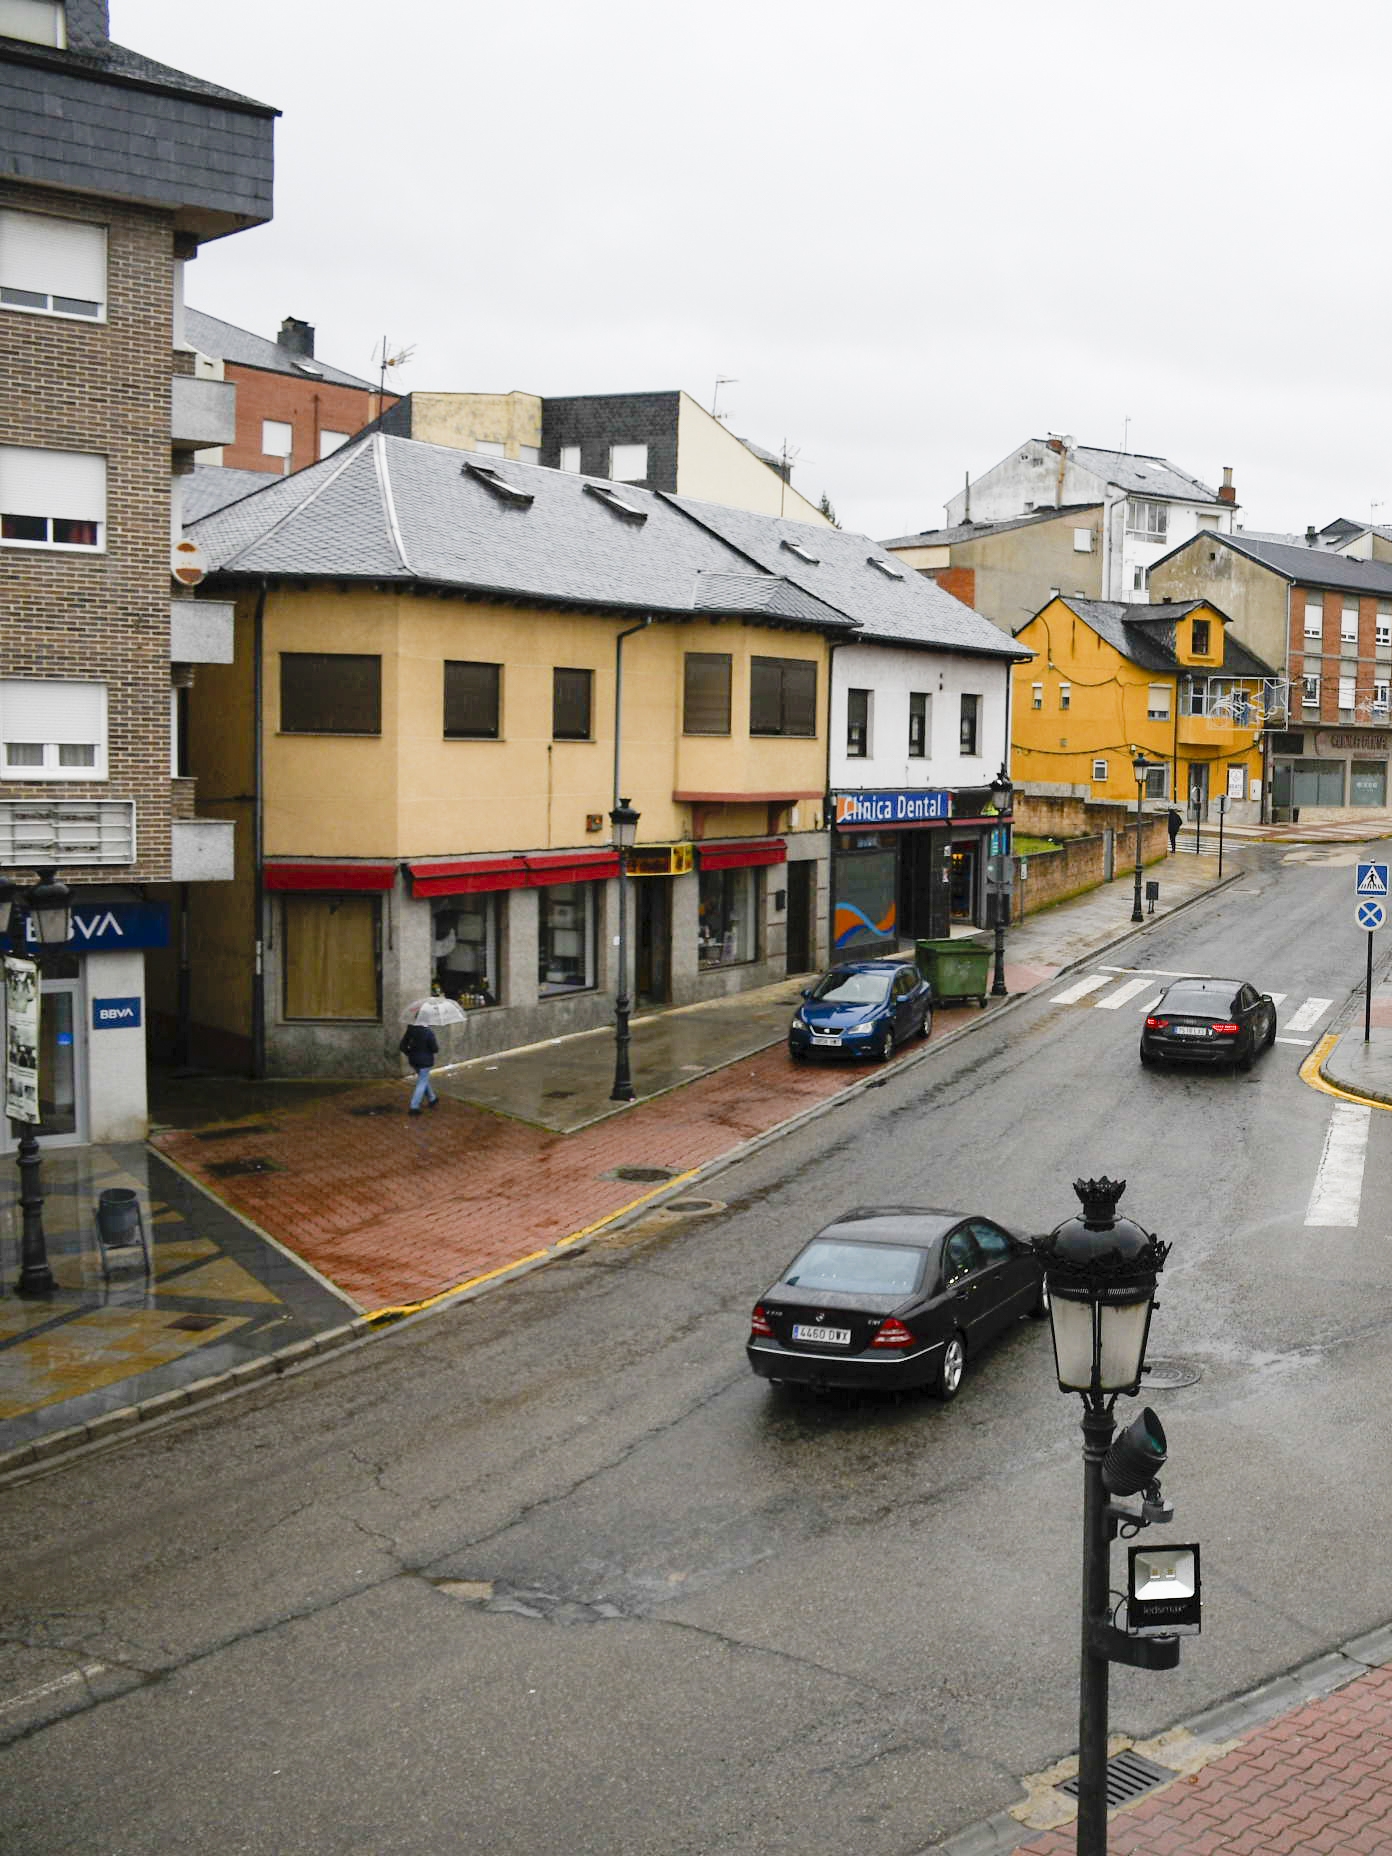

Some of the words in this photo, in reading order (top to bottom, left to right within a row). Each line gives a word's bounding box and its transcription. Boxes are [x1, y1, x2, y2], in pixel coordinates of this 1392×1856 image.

[844, 794, 892, 820] Clínica
[897, 794, 941, 818] Dental
[26, 912, 123, 942] VA
[100, 1008, 134, 1020] BBVA
[800, 1327, 826, 1339] 4460
[828, 1329, 848, 1342] DWX
